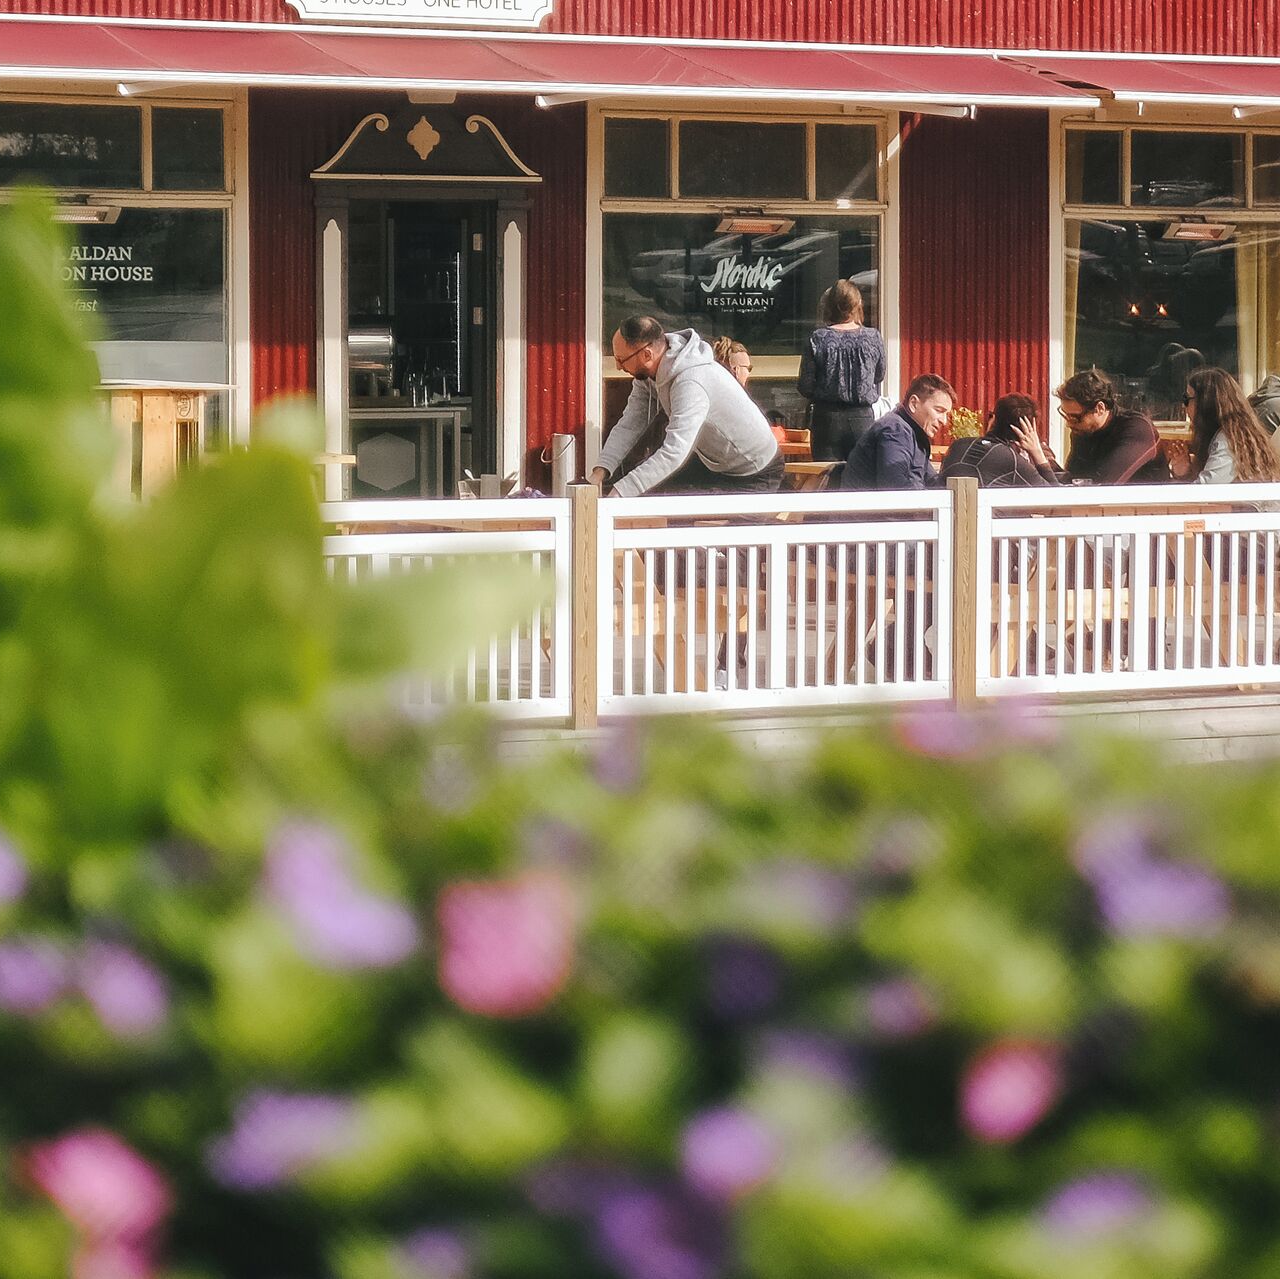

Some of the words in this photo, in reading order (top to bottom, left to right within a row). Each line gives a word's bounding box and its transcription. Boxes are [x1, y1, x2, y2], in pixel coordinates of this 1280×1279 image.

[69, 246, 133, 260] ALDAN
[61, 266, 87, 281] ON
[90, 266, 153, 281] HOUSE
[700, 254, 783, 293] Nordic
[706, 297, 775, 306] RESTAURANT
